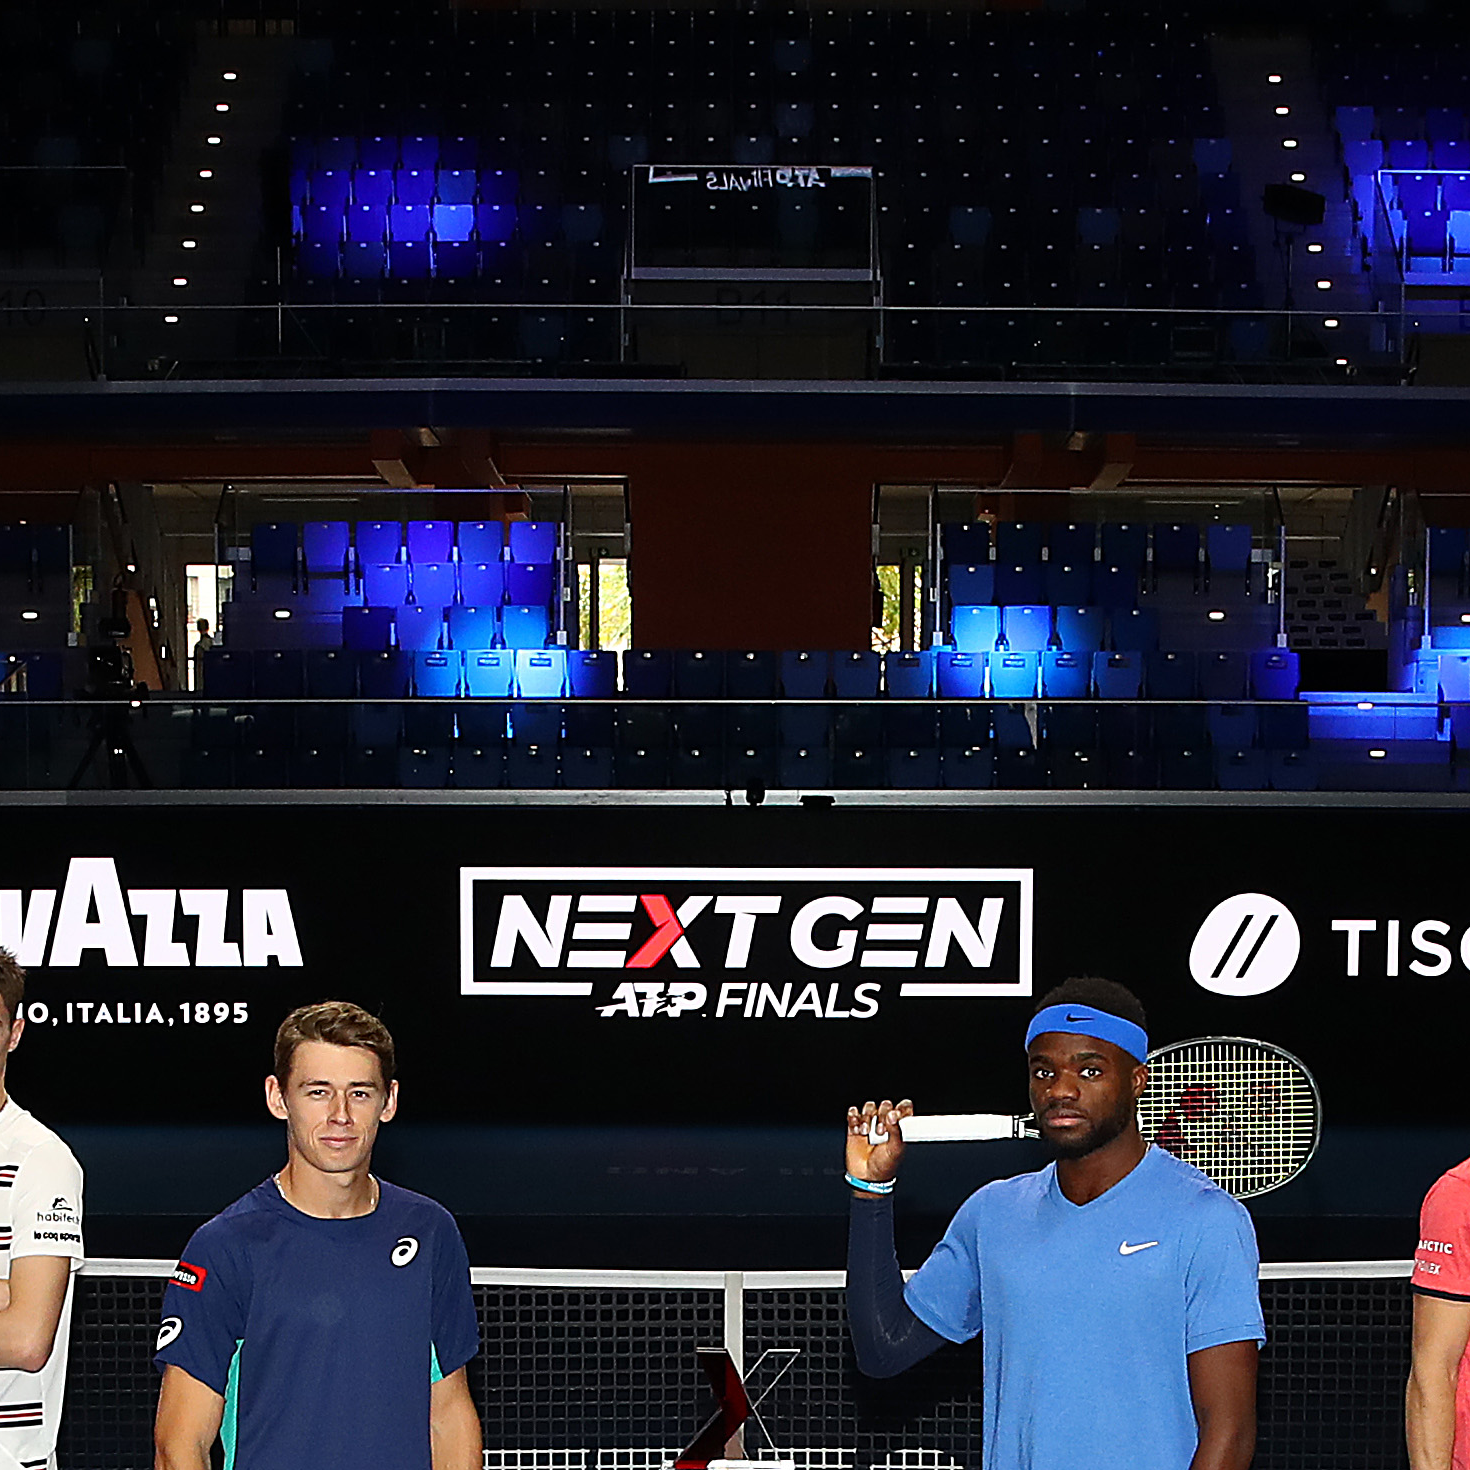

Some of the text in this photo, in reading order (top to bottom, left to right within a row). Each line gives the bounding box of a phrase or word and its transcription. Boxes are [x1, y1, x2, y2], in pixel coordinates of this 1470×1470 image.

[489, 893, 1005, 969] NEXT GEN
[595, 982, 882, 1019] ATP FINALS
